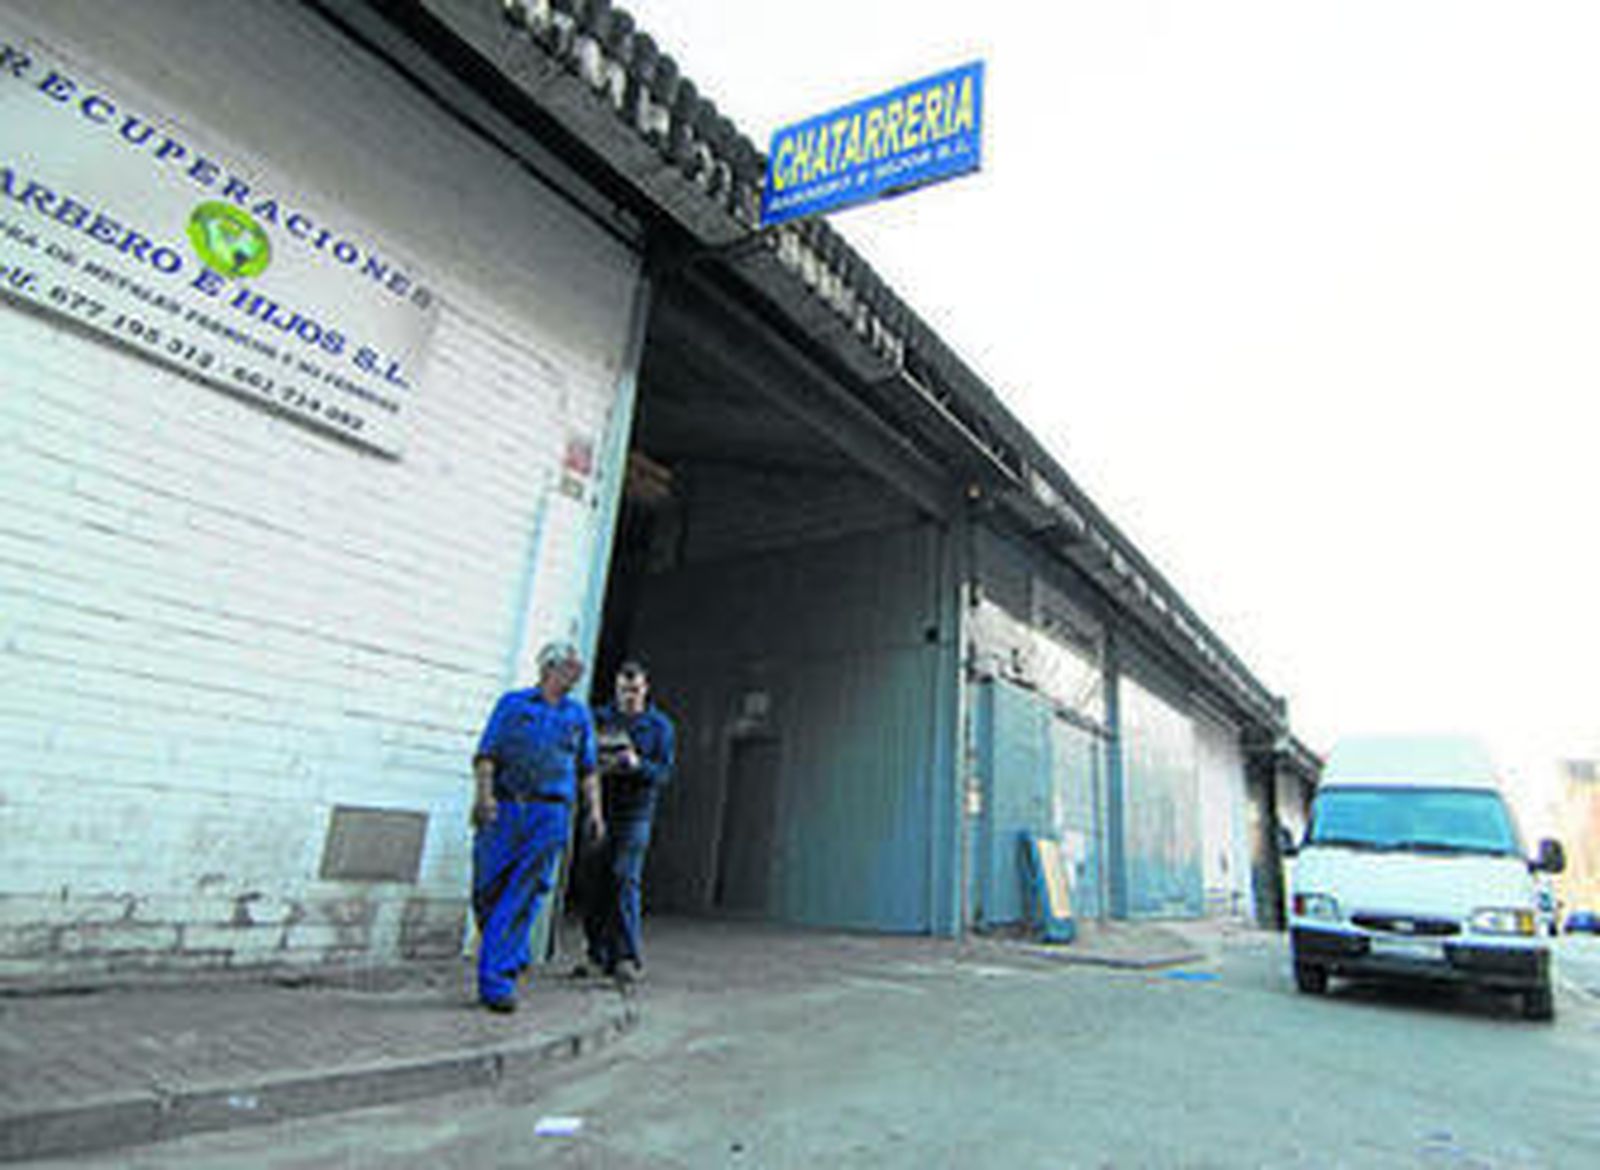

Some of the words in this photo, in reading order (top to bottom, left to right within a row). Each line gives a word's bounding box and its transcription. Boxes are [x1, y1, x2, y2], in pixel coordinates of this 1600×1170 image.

[0, 44, 432, 310] RECUPERACIONES
[773, 77, 972, 190] CHATARRERIA
[191, 267, 225, 297] E
[231, 288, 346, 355] HIJOS
[353, 347, 411, 390] S.L.
